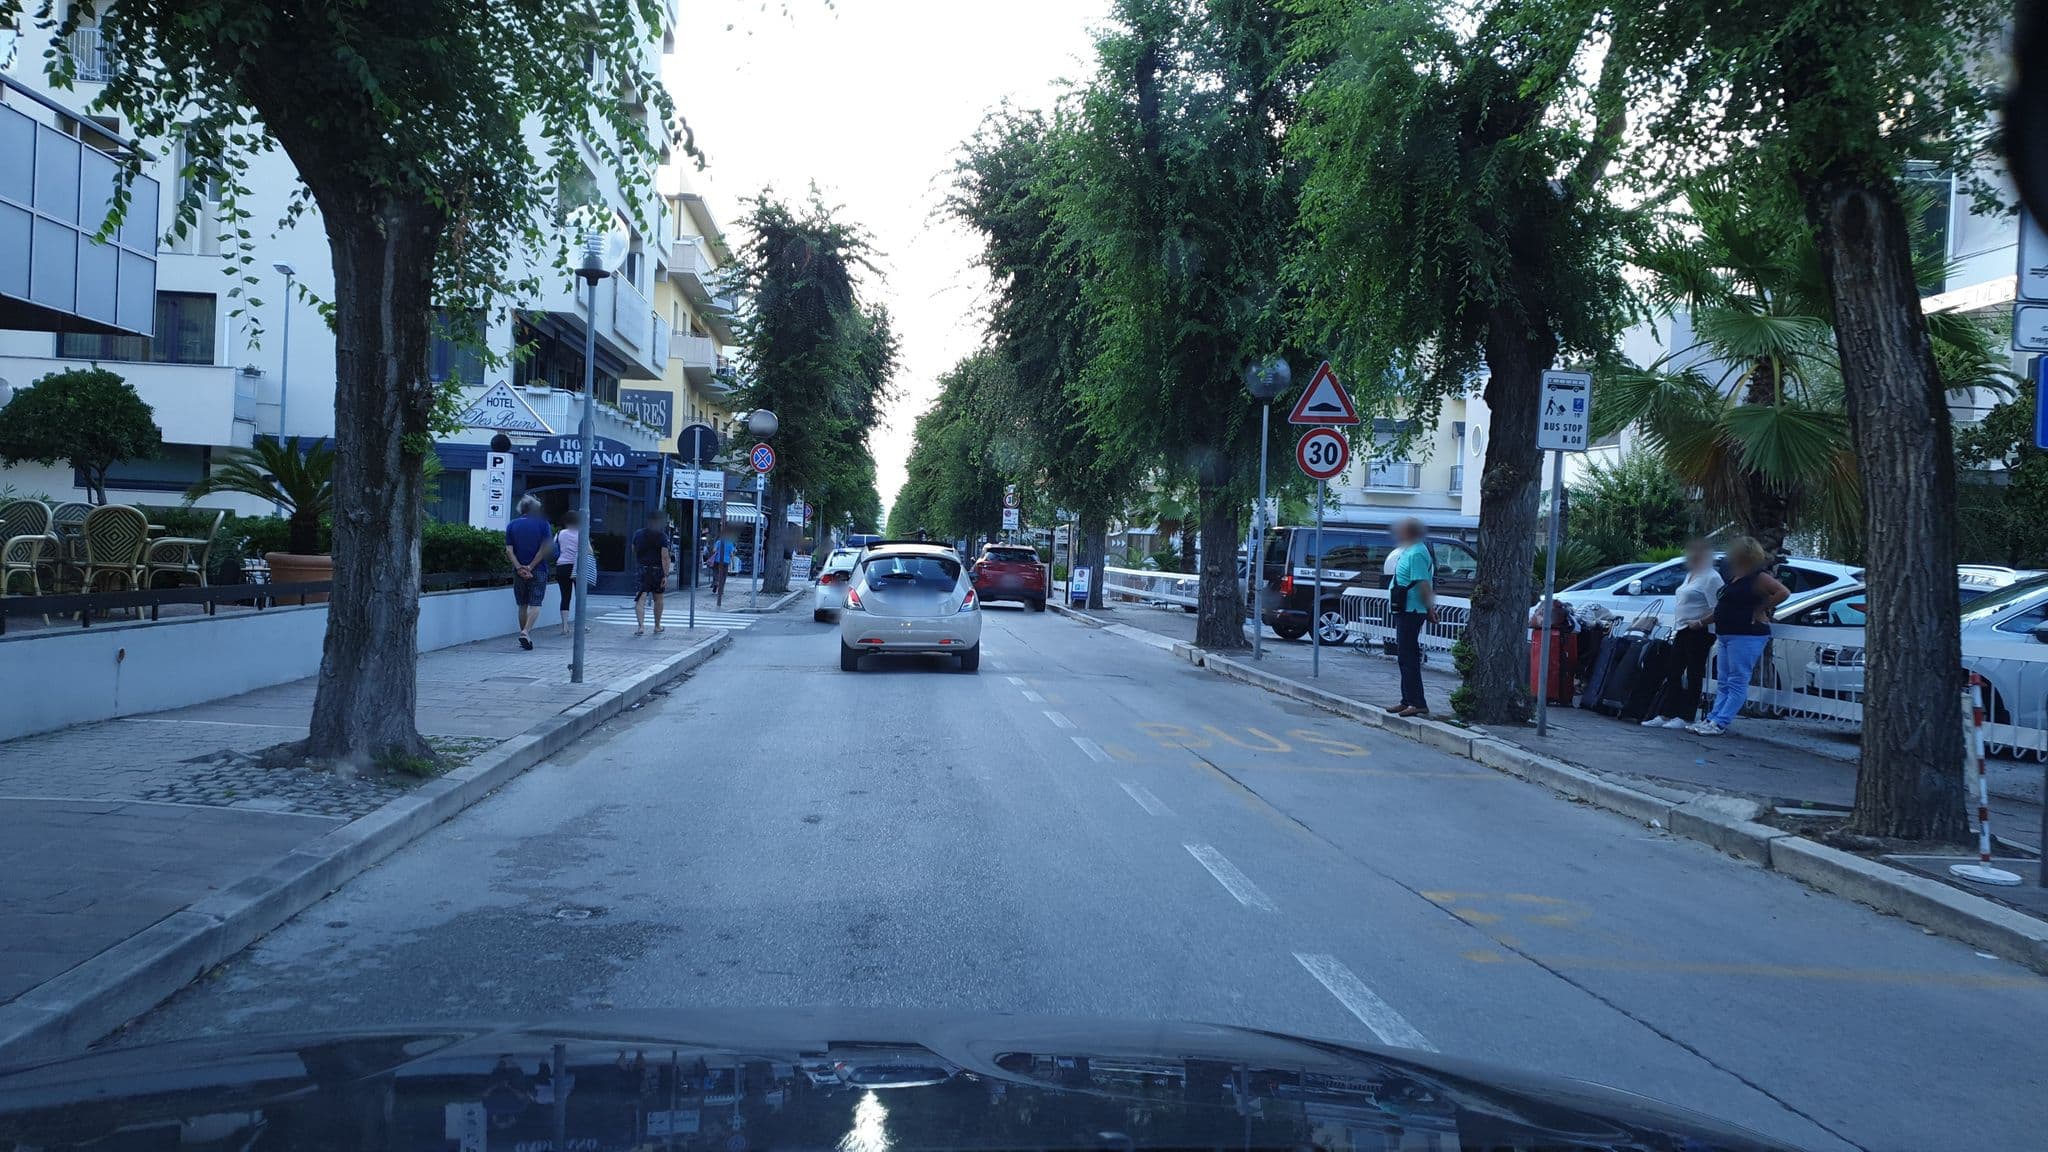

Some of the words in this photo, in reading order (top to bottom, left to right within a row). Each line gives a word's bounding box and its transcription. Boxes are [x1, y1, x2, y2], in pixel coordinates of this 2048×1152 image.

[487, 397, 515, 409] HOTEL
[462, 407, 492, 425] Des
[494, 409, 537, 429] Bains
[1544, 422, 1560, 431] BUS
[1563, 423, 1583, 433] STOP
[560, 439, 607, 451] HOEL
[541, 449, 625, 467] GABBANO
[1308, 441, 1338, 466] 30
[492, 456, 504, 467] P
[1300, 569, 1345, 578] SHTTLE
[1137, 722, 1372, 758] BUS
